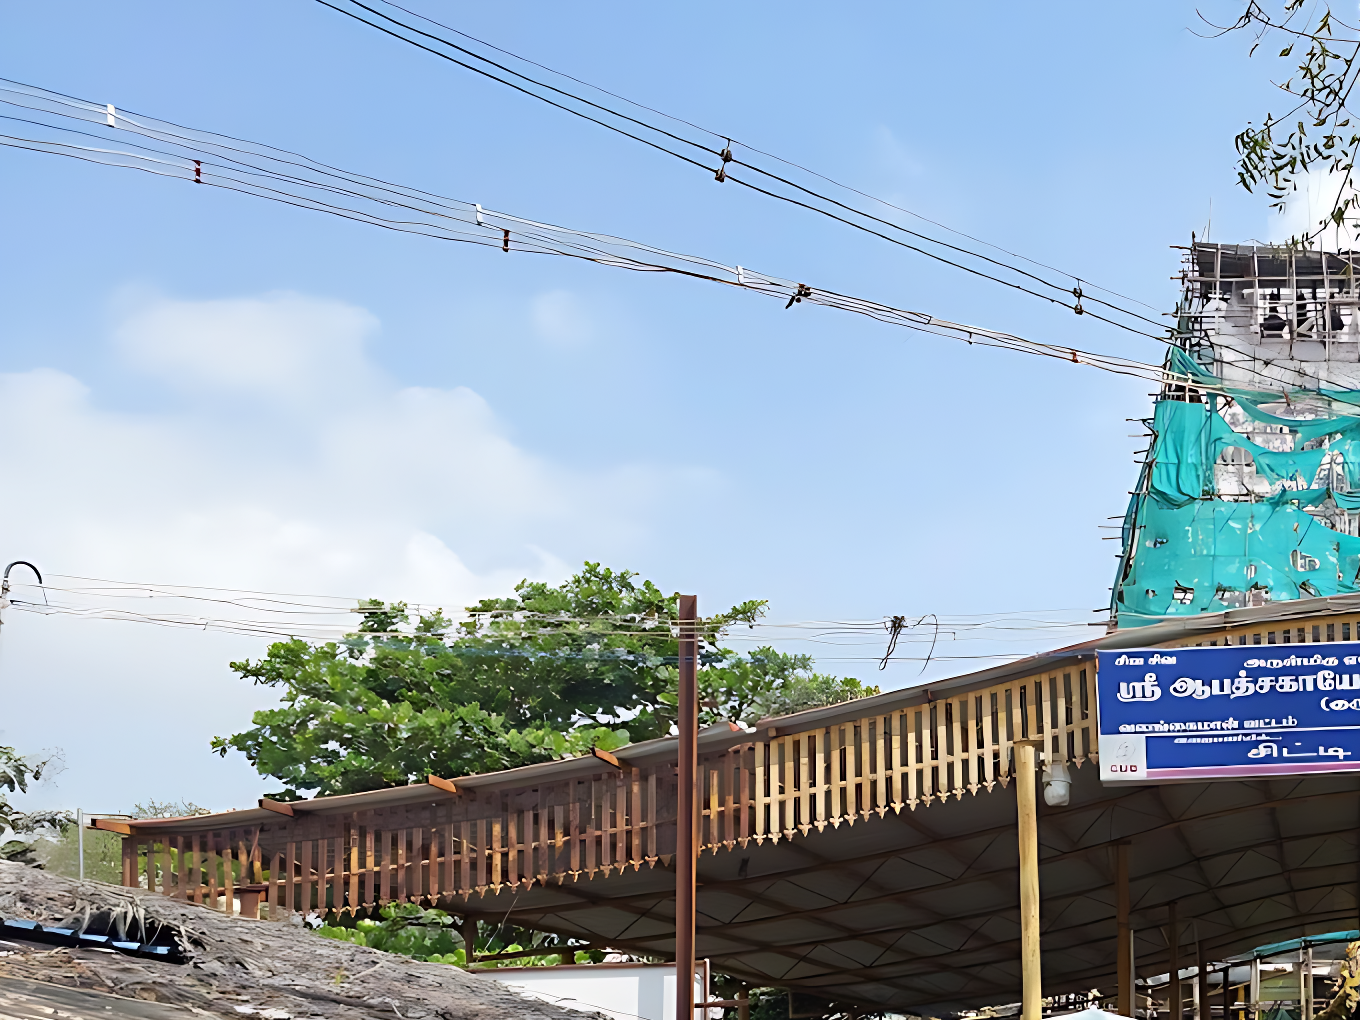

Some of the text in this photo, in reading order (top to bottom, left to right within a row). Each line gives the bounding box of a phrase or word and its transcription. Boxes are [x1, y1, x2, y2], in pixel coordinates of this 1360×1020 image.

[1117, 672, 1162, 702] ஸ்ரீ
[1243, 715, 1298, 728] வட்டம்
[1247, 741, 1351, 760] சிட்டி
